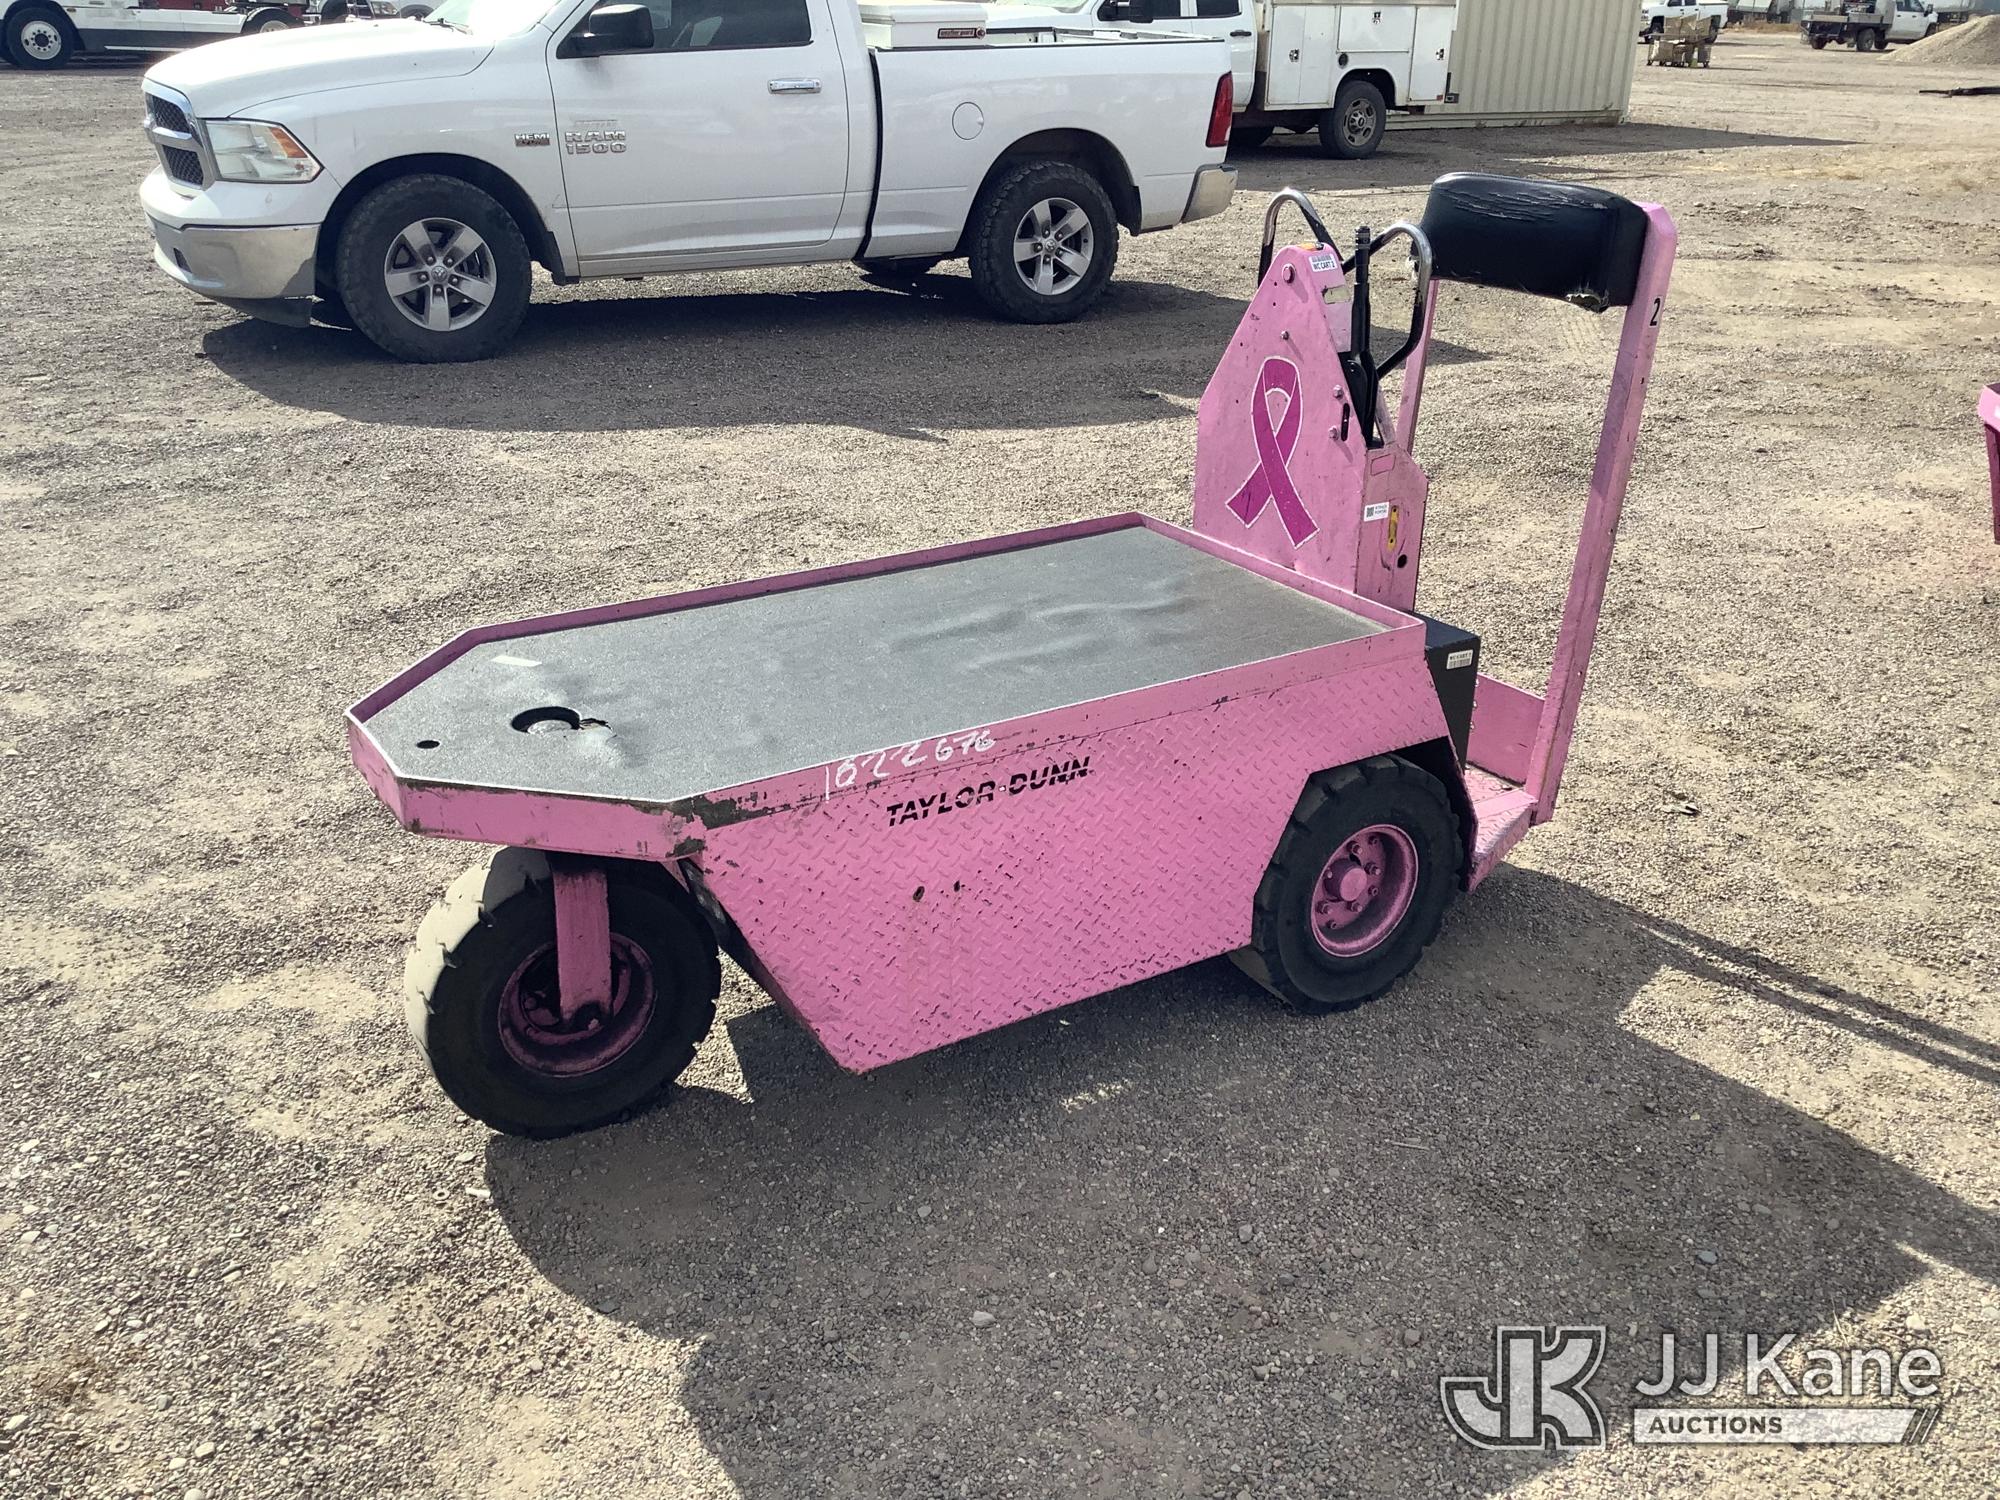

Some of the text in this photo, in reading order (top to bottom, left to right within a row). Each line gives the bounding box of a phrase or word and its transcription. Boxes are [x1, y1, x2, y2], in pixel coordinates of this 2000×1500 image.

[565, 130, 626, 142] RAM
[566, 142, 627, 154] 1500
[1649, 297, 1661, 326] 2
